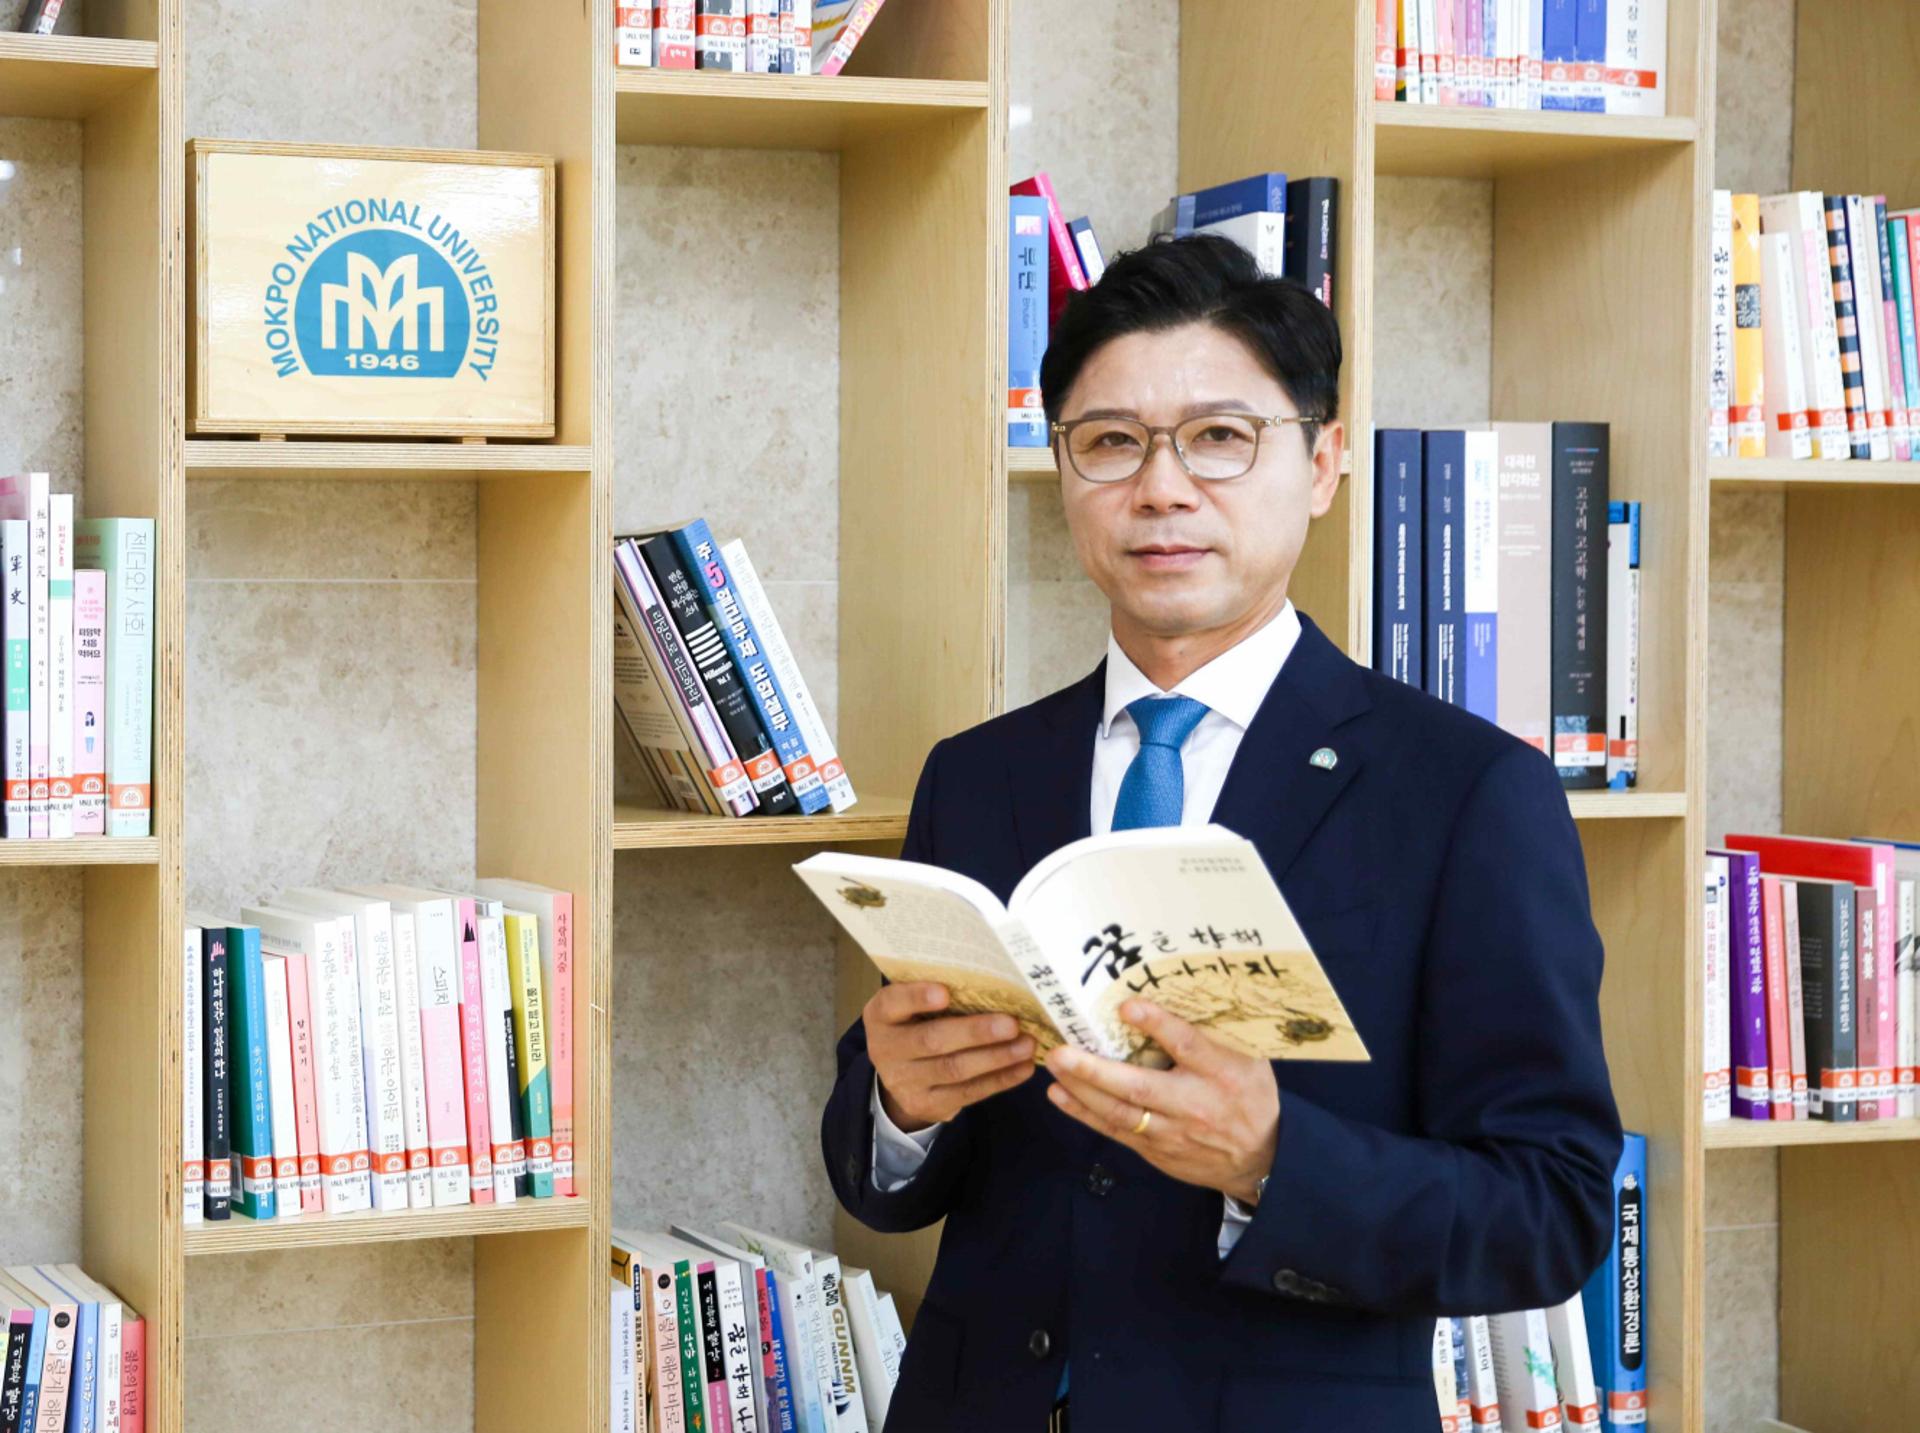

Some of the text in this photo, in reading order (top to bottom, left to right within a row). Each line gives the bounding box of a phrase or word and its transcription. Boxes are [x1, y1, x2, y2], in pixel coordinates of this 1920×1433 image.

[263, 198, 500, 382] MOKPO NATIONAL UNIVERSITY
[344, 353, 420, 371] 1946
[1576, 486, 1588, 532] 고구려
[1576, 535, 1588, 582] 고고학
[124, 531, 147, 637] 젠더와 사회
[651, 610, 701, 703] 리딩으로 리드하라
[375, 930, 391, 985] 생각하는
[557, 914, 567, 974] 사랑의 기술
[1189, 924, 1264, 950] 향해
[433, 965, 450, 1006] 스피치
[1126, 954, 1289, 993] 나아가자
[378, 988, 393, 1016] 교실
[528, 1008, 541, 1029] 말고
[530, 1032, 543, 1063] 떠나라
[255, 1080, 266, 1124] 필요하다
[383, 1078, 400, 1121] 아이들
[45, 1339, 69, 1394] 이렇게
[658, 1298, 681, 1429] 이렇게 해야 바로
[831, 1307, 857, 1394] GUNNM
[3, 1386, 21, 1421] 빨강
[123, 1350, 138, 1415] 젊음의 탄생
